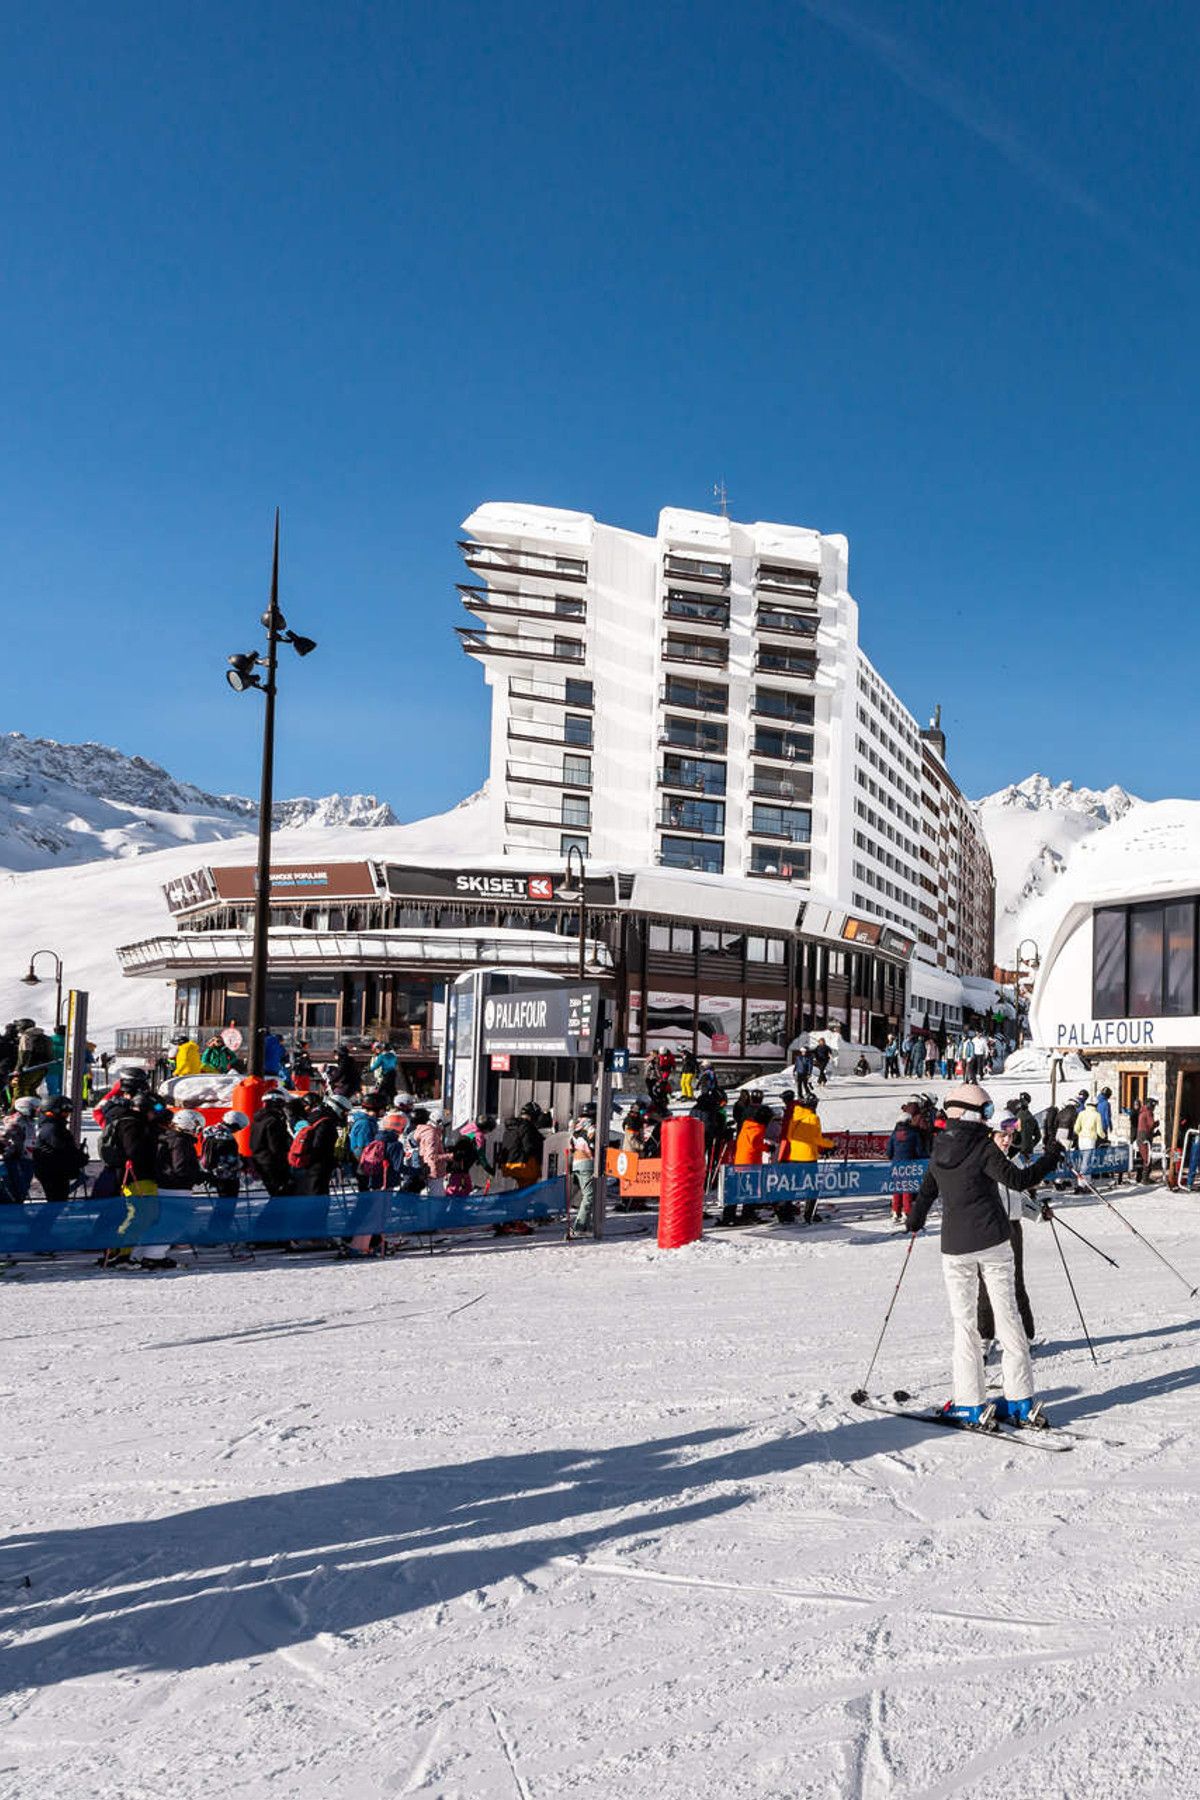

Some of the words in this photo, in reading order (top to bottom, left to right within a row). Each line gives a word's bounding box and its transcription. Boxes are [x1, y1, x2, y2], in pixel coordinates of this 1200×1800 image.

[456, 876, 527, 893] SKISET
[496, 1000, 548, 1029] PALAFOUR
[1058, 1021, 1154, 1046] PALAFOUR
[766, 1171, 861, 1193] PALAFOUR
